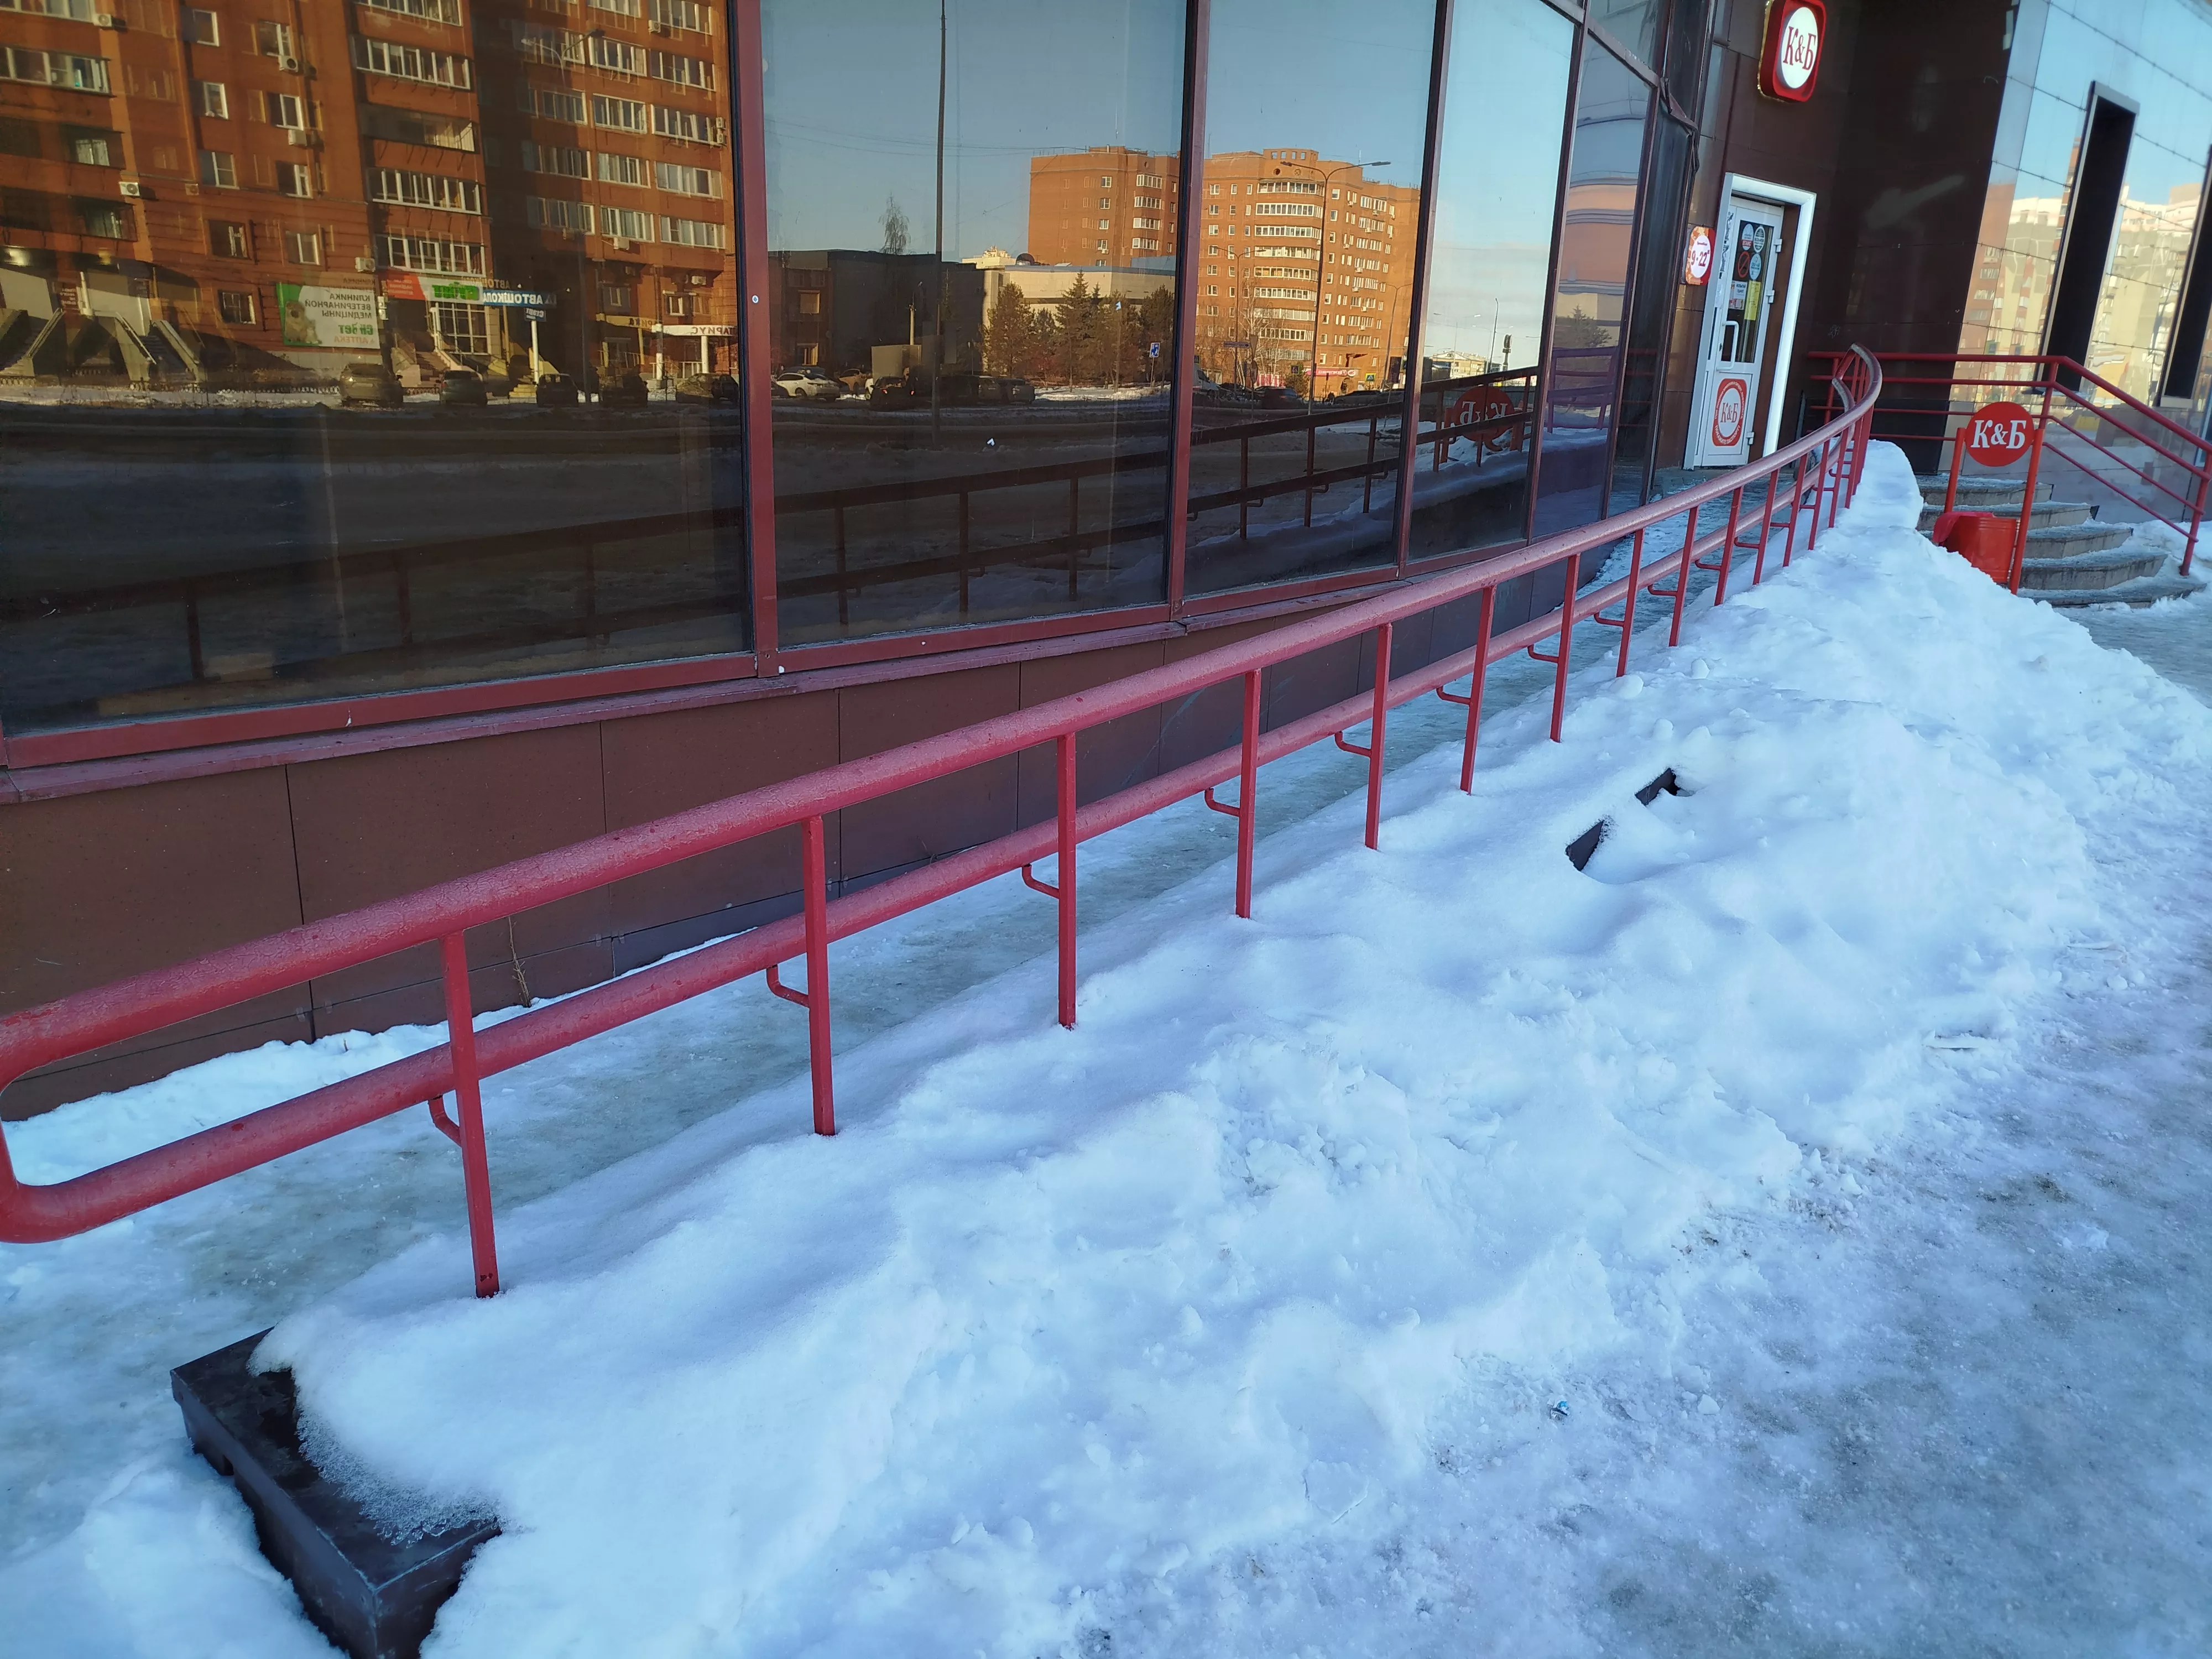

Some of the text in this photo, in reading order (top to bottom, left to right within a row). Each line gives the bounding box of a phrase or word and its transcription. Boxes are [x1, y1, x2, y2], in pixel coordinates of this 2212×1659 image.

[1783, 26, 1817, 70] К&Б
[1720, 403, 1739, 423] К&Б
[1970, 419, 2027, 449] К&Б
